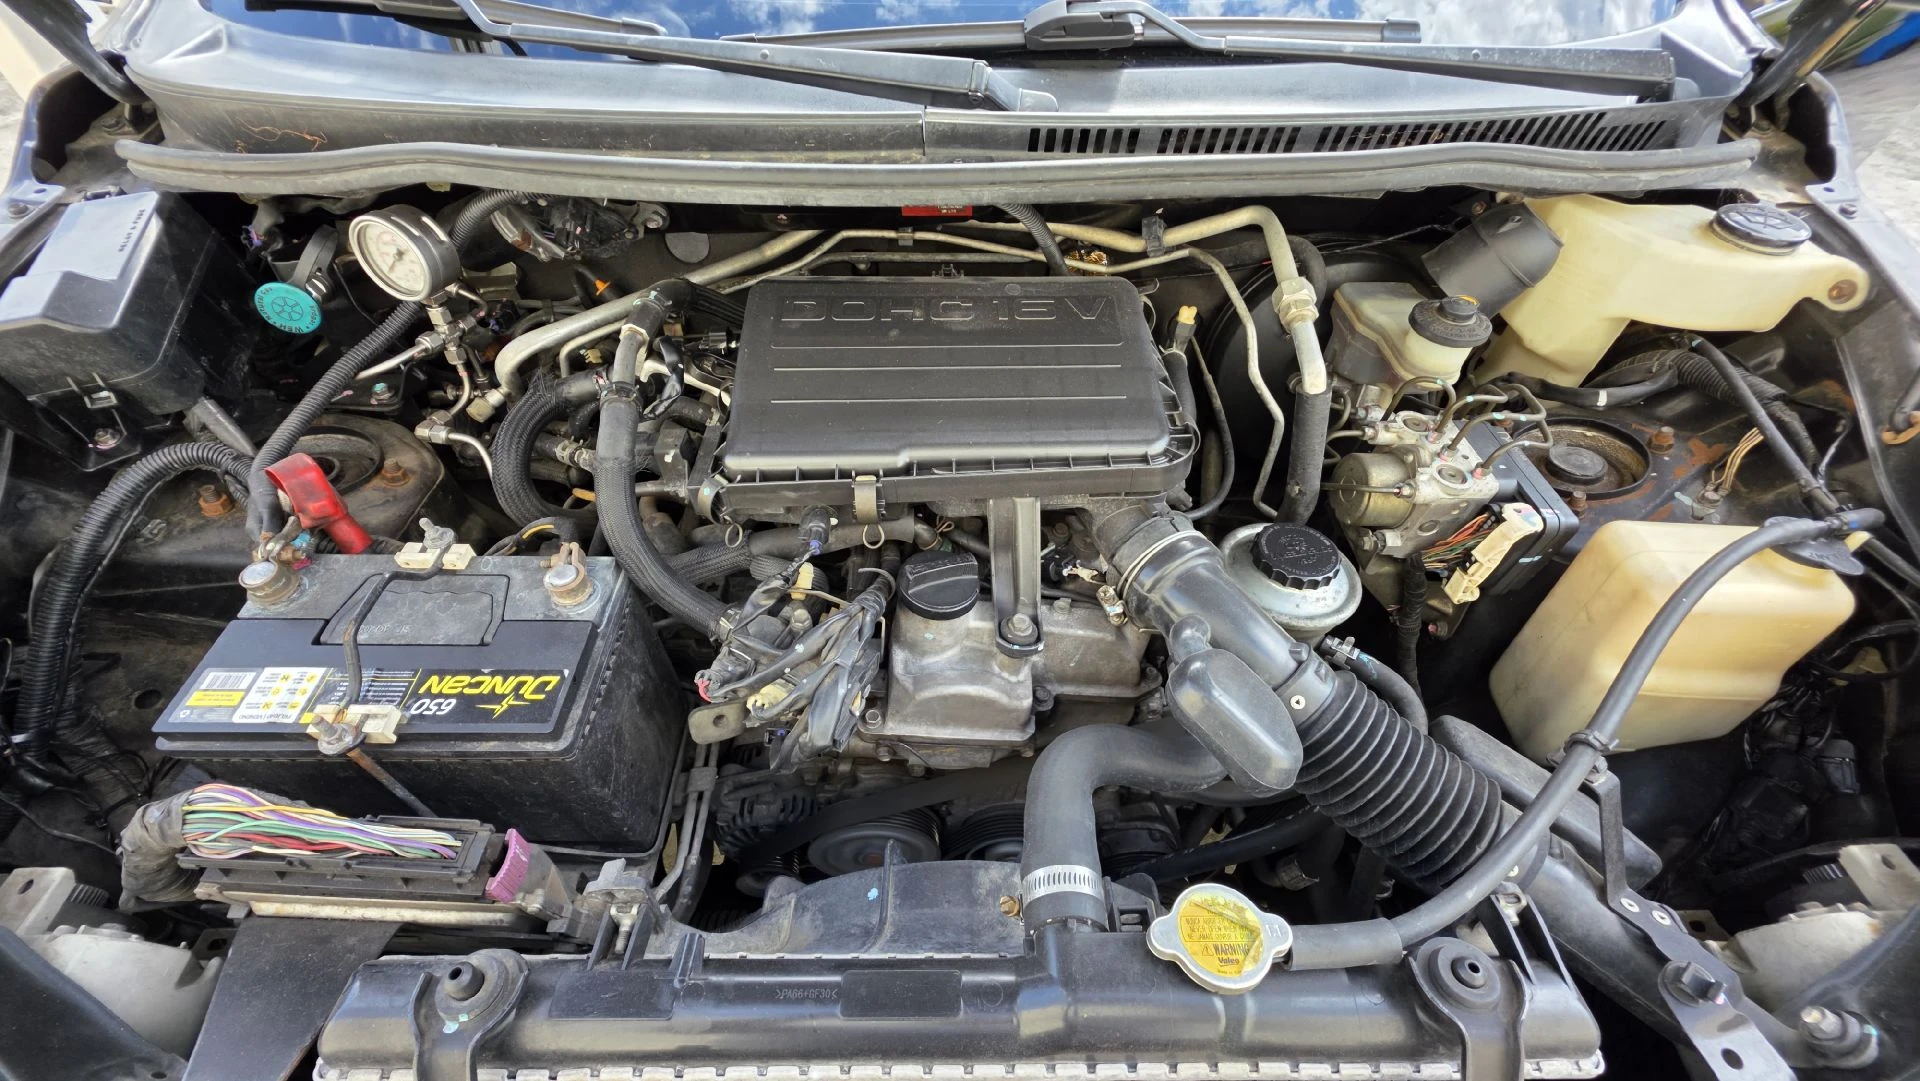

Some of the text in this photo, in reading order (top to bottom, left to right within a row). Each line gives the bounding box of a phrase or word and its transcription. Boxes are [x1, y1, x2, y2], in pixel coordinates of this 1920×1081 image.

[780, 297, 976, 321] DOHC
[279, 323, 305, 333] WEH
[418, 675, 561, 700] DUNCAN
[410, 698, 457, 716] 650
[1213, 943, 1249, 956] WARNING
[1217, 957, 1240, 966] Valeo
